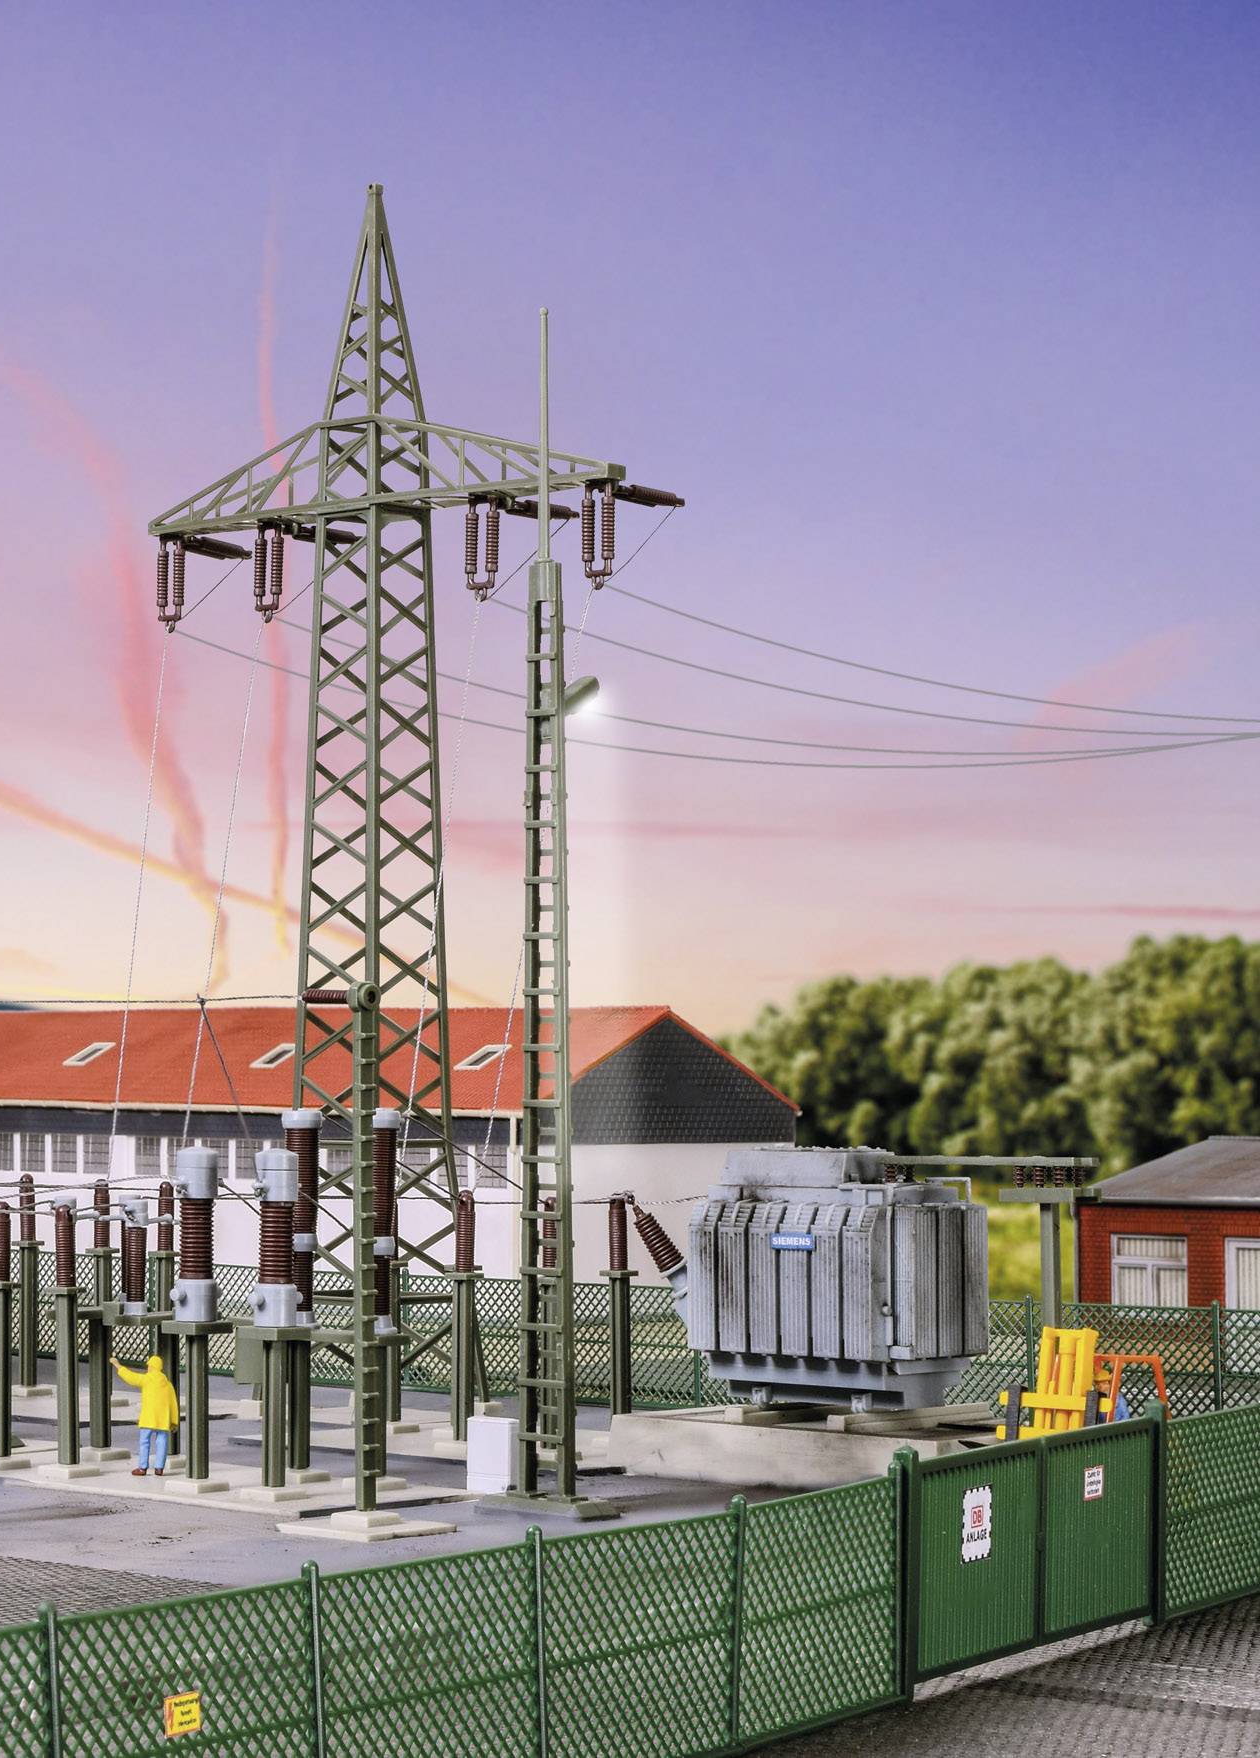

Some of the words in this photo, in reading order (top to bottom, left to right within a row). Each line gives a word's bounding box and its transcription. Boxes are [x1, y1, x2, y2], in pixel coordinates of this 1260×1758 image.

[772, 1236, 811, 1246] SIEMENS
[972, 1508, 982, 1525] DB
[965, 1528, 988, 1544] ANLAGE
